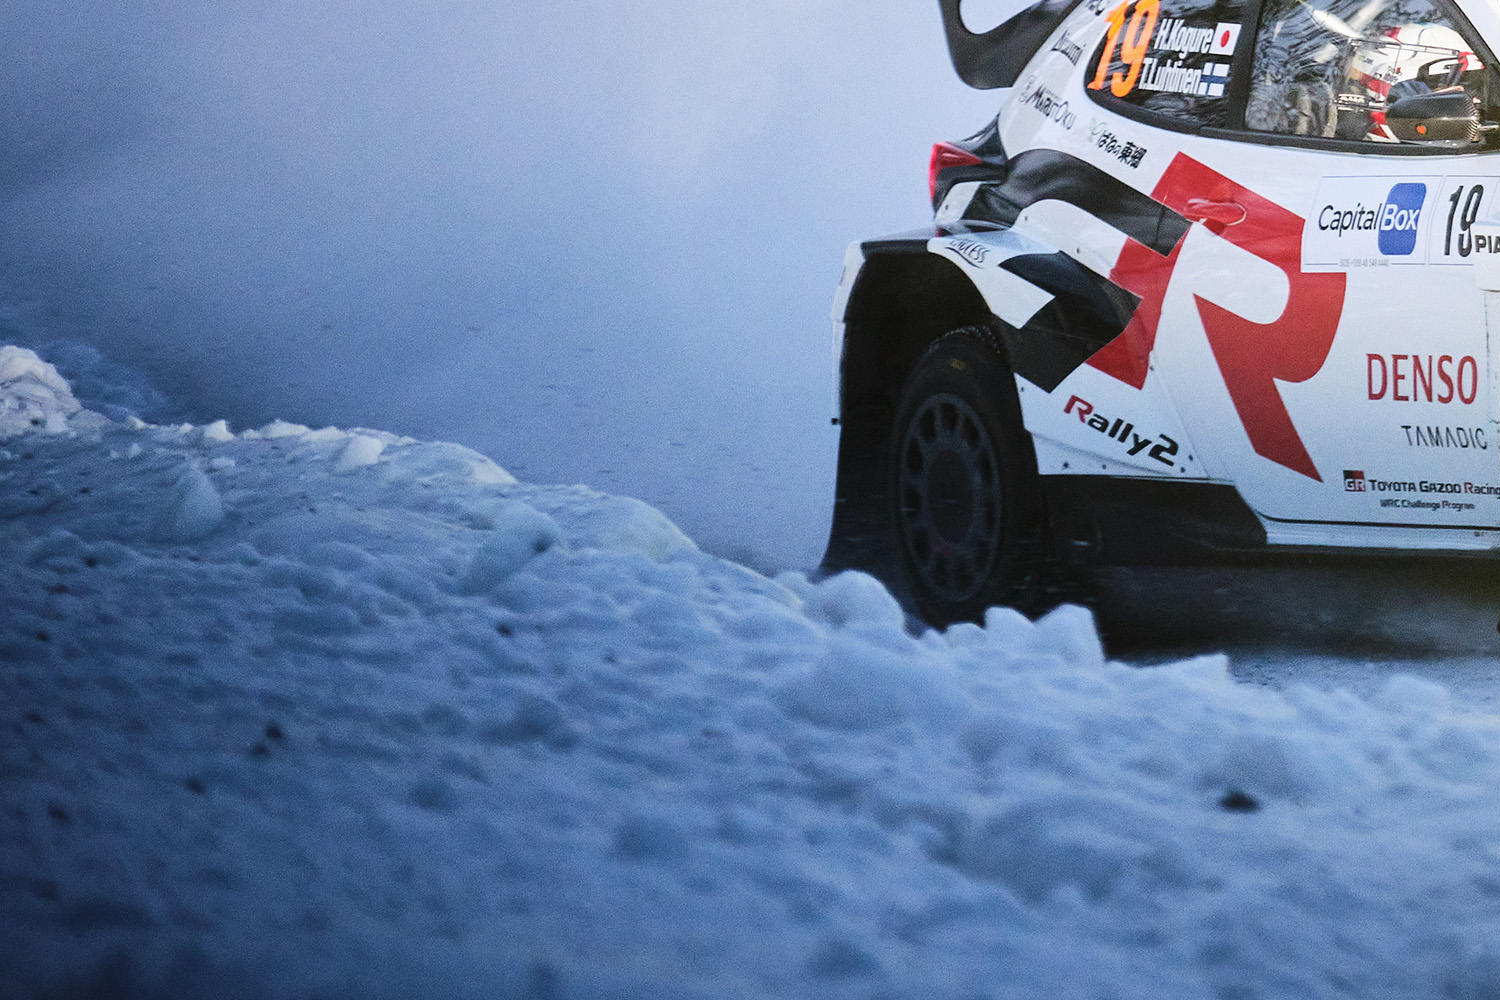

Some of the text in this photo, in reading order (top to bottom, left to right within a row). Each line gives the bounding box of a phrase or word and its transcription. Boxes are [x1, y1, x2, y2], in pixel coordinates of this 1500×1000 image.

[1153, 18, 1215, 59] H.Kogure
[1443, 183, 1484, 258] 19
[1366, 353, 1478, 405] DENSO
[1064, 394, 1179, 467] Rally2
[1401, 425, 1488, 450] TAMADIC
[1401, 499, 1441, 511] Challenge
[1441, 501, 1475, 511] Program
[1418, 480, 1462, 494] GAZOO
